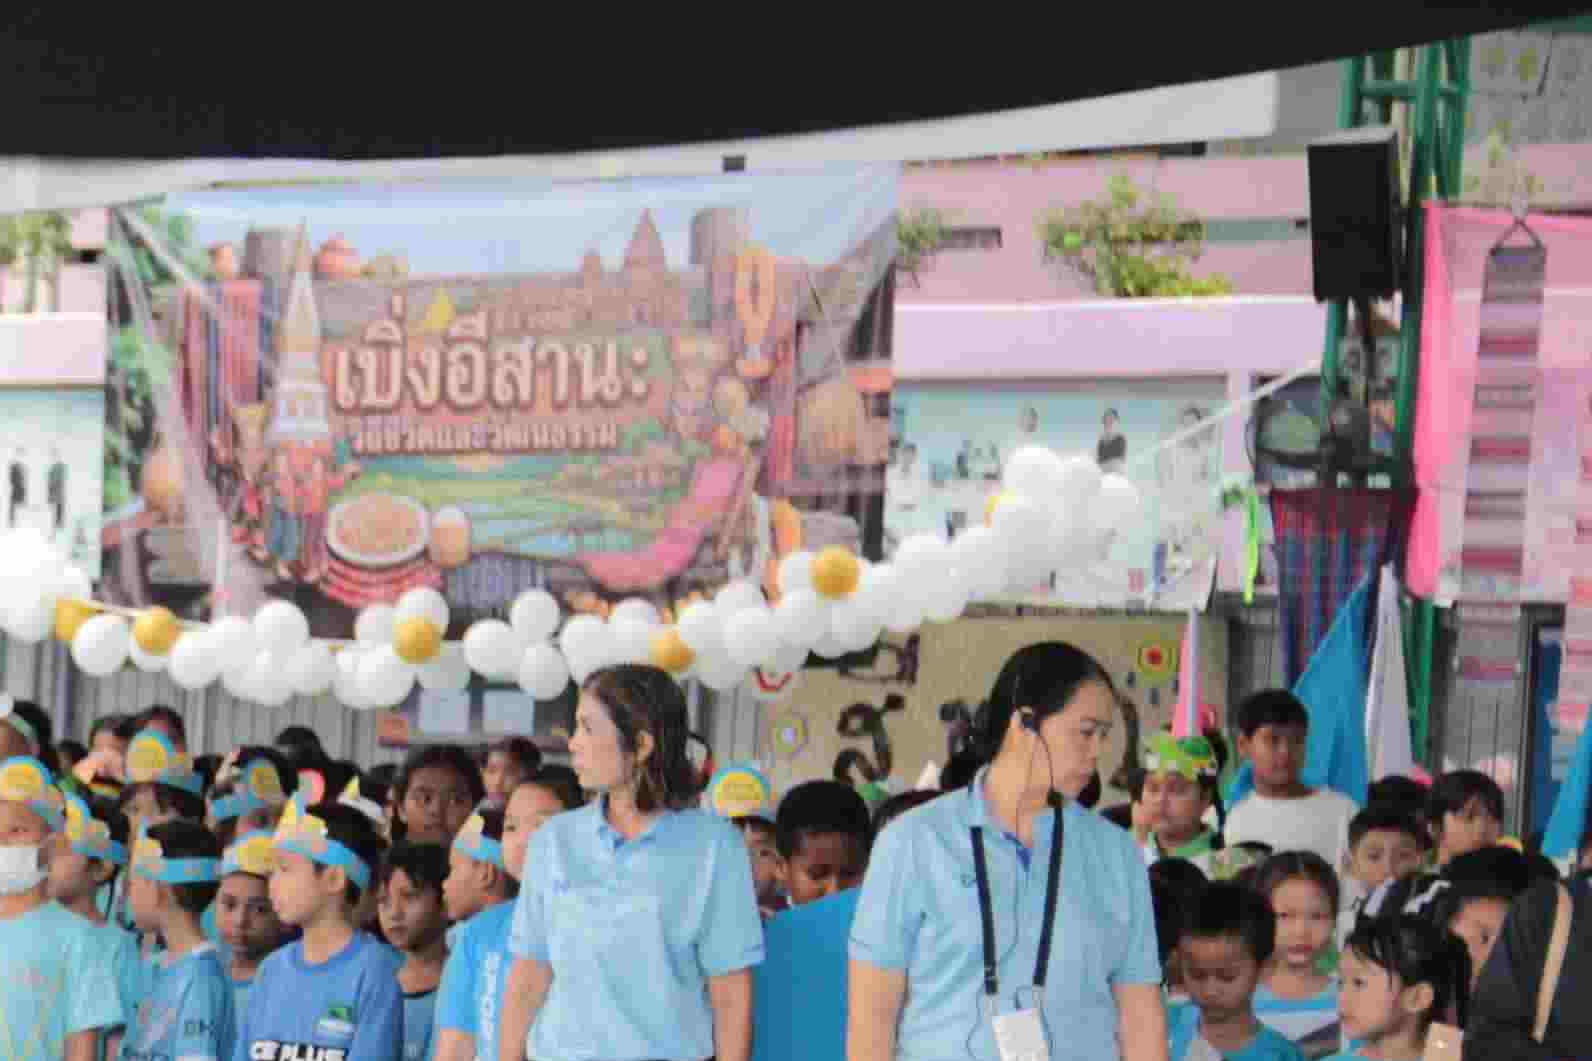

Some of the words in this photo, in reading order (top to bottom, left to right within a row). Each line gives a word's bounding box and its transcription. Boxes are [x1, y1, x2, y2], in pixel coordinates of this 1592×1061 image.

[334, 293, 649, 408] เบิ่งอีสานะ
